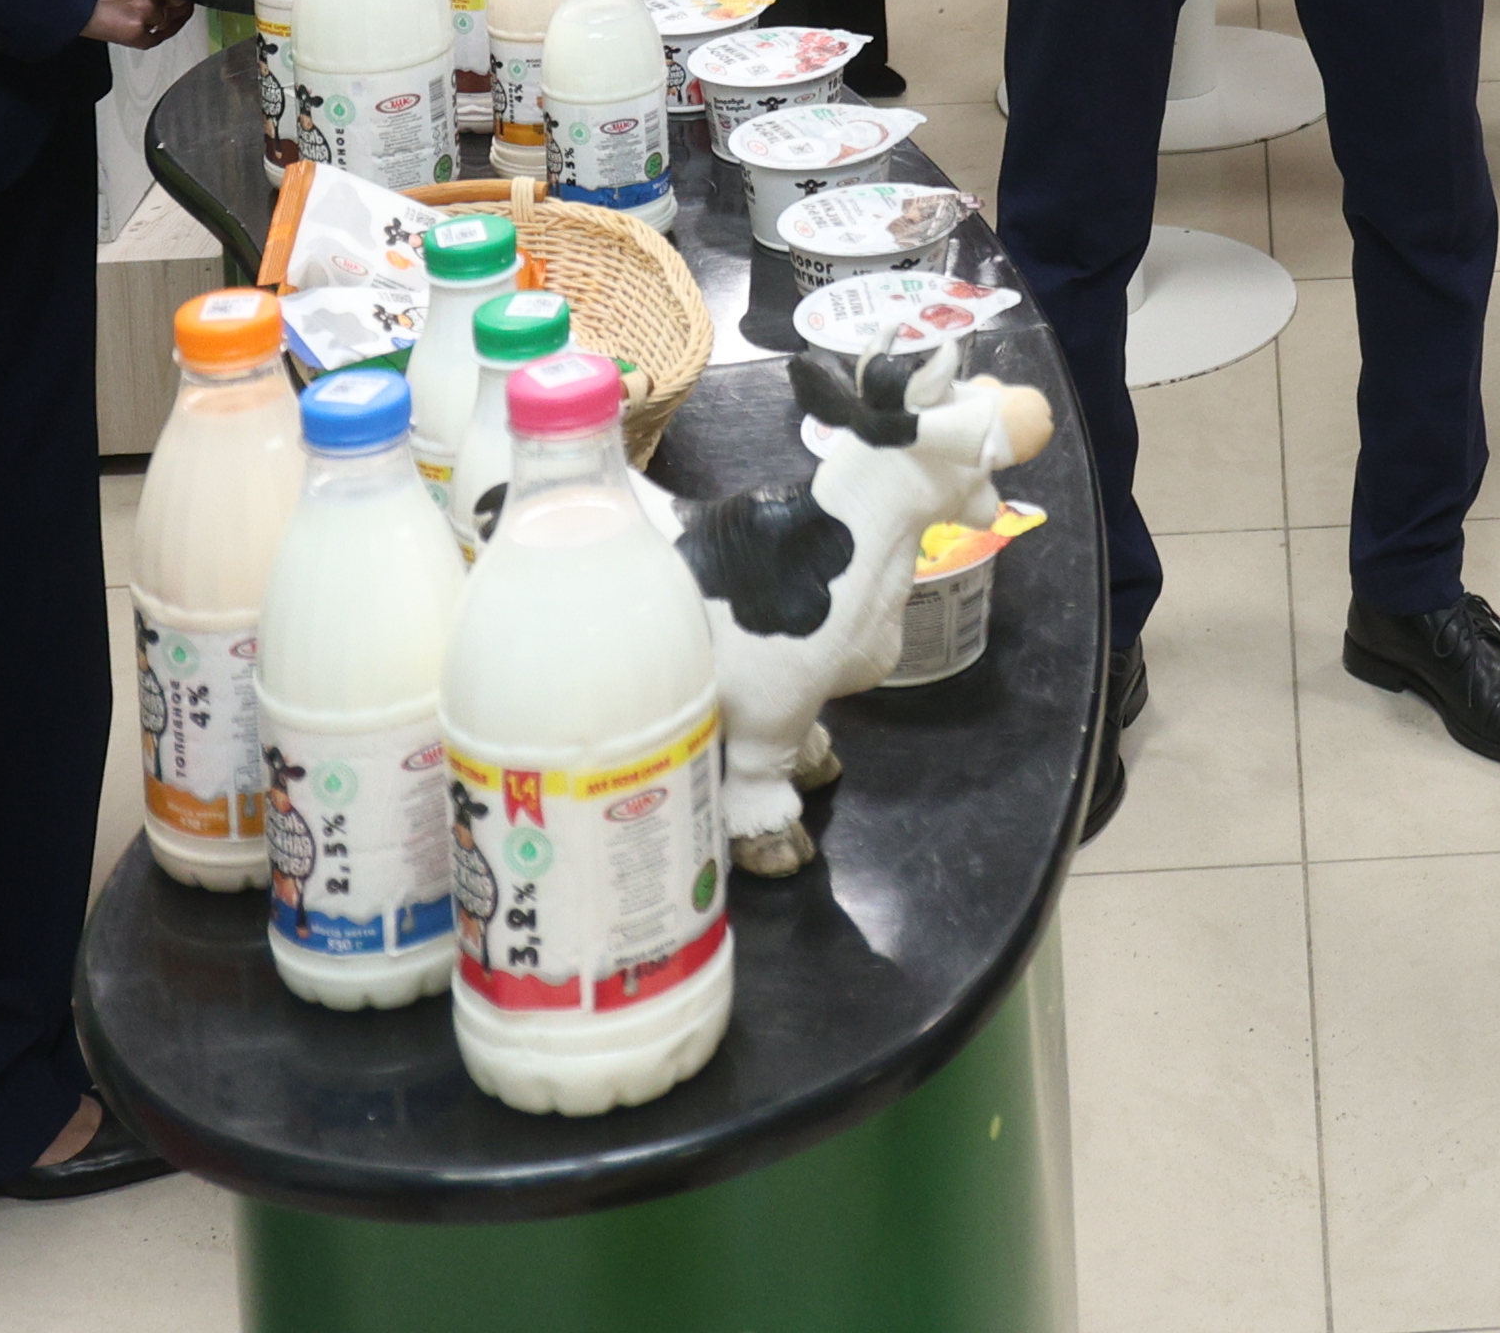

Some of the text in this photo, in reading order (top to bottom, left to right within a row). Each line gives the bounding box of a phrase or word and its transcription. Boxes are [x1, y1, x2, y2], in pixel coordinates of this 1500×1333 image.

[187, 684, 211, 729] 4%
[322, 814, 350, 895] 2,5%
[506, 882, 543, 967] 3,2%
